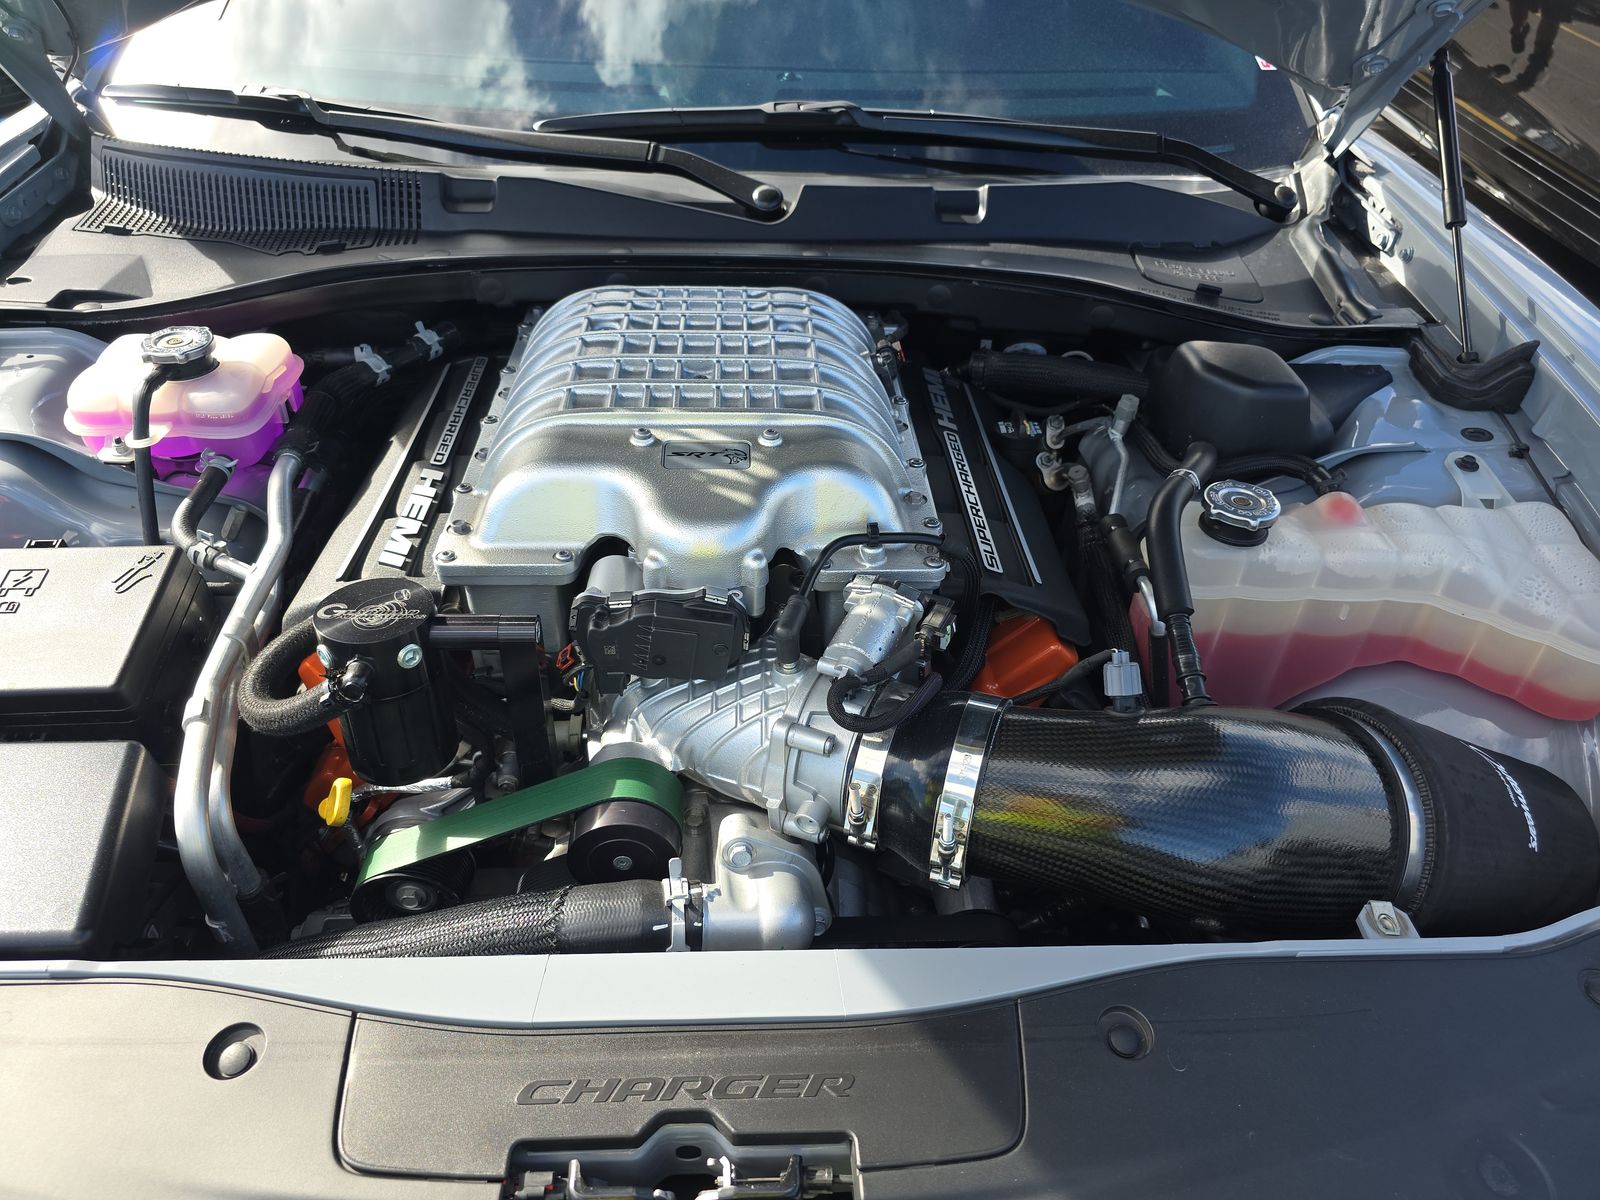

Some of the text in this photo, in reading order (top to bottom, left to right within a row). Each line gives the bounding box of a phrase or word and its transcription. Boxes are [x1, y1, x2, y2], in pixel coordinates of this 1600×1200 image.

[433, 357, 487, 463] SUPERCHARGED
[666, 451, 724, 459] SRT
[378, 468, 444, 567] HEMI
[921, 367, 1000, 570] SUPERCHARGED HEMI
[515, 1073, 856, 1105] CHARGER
